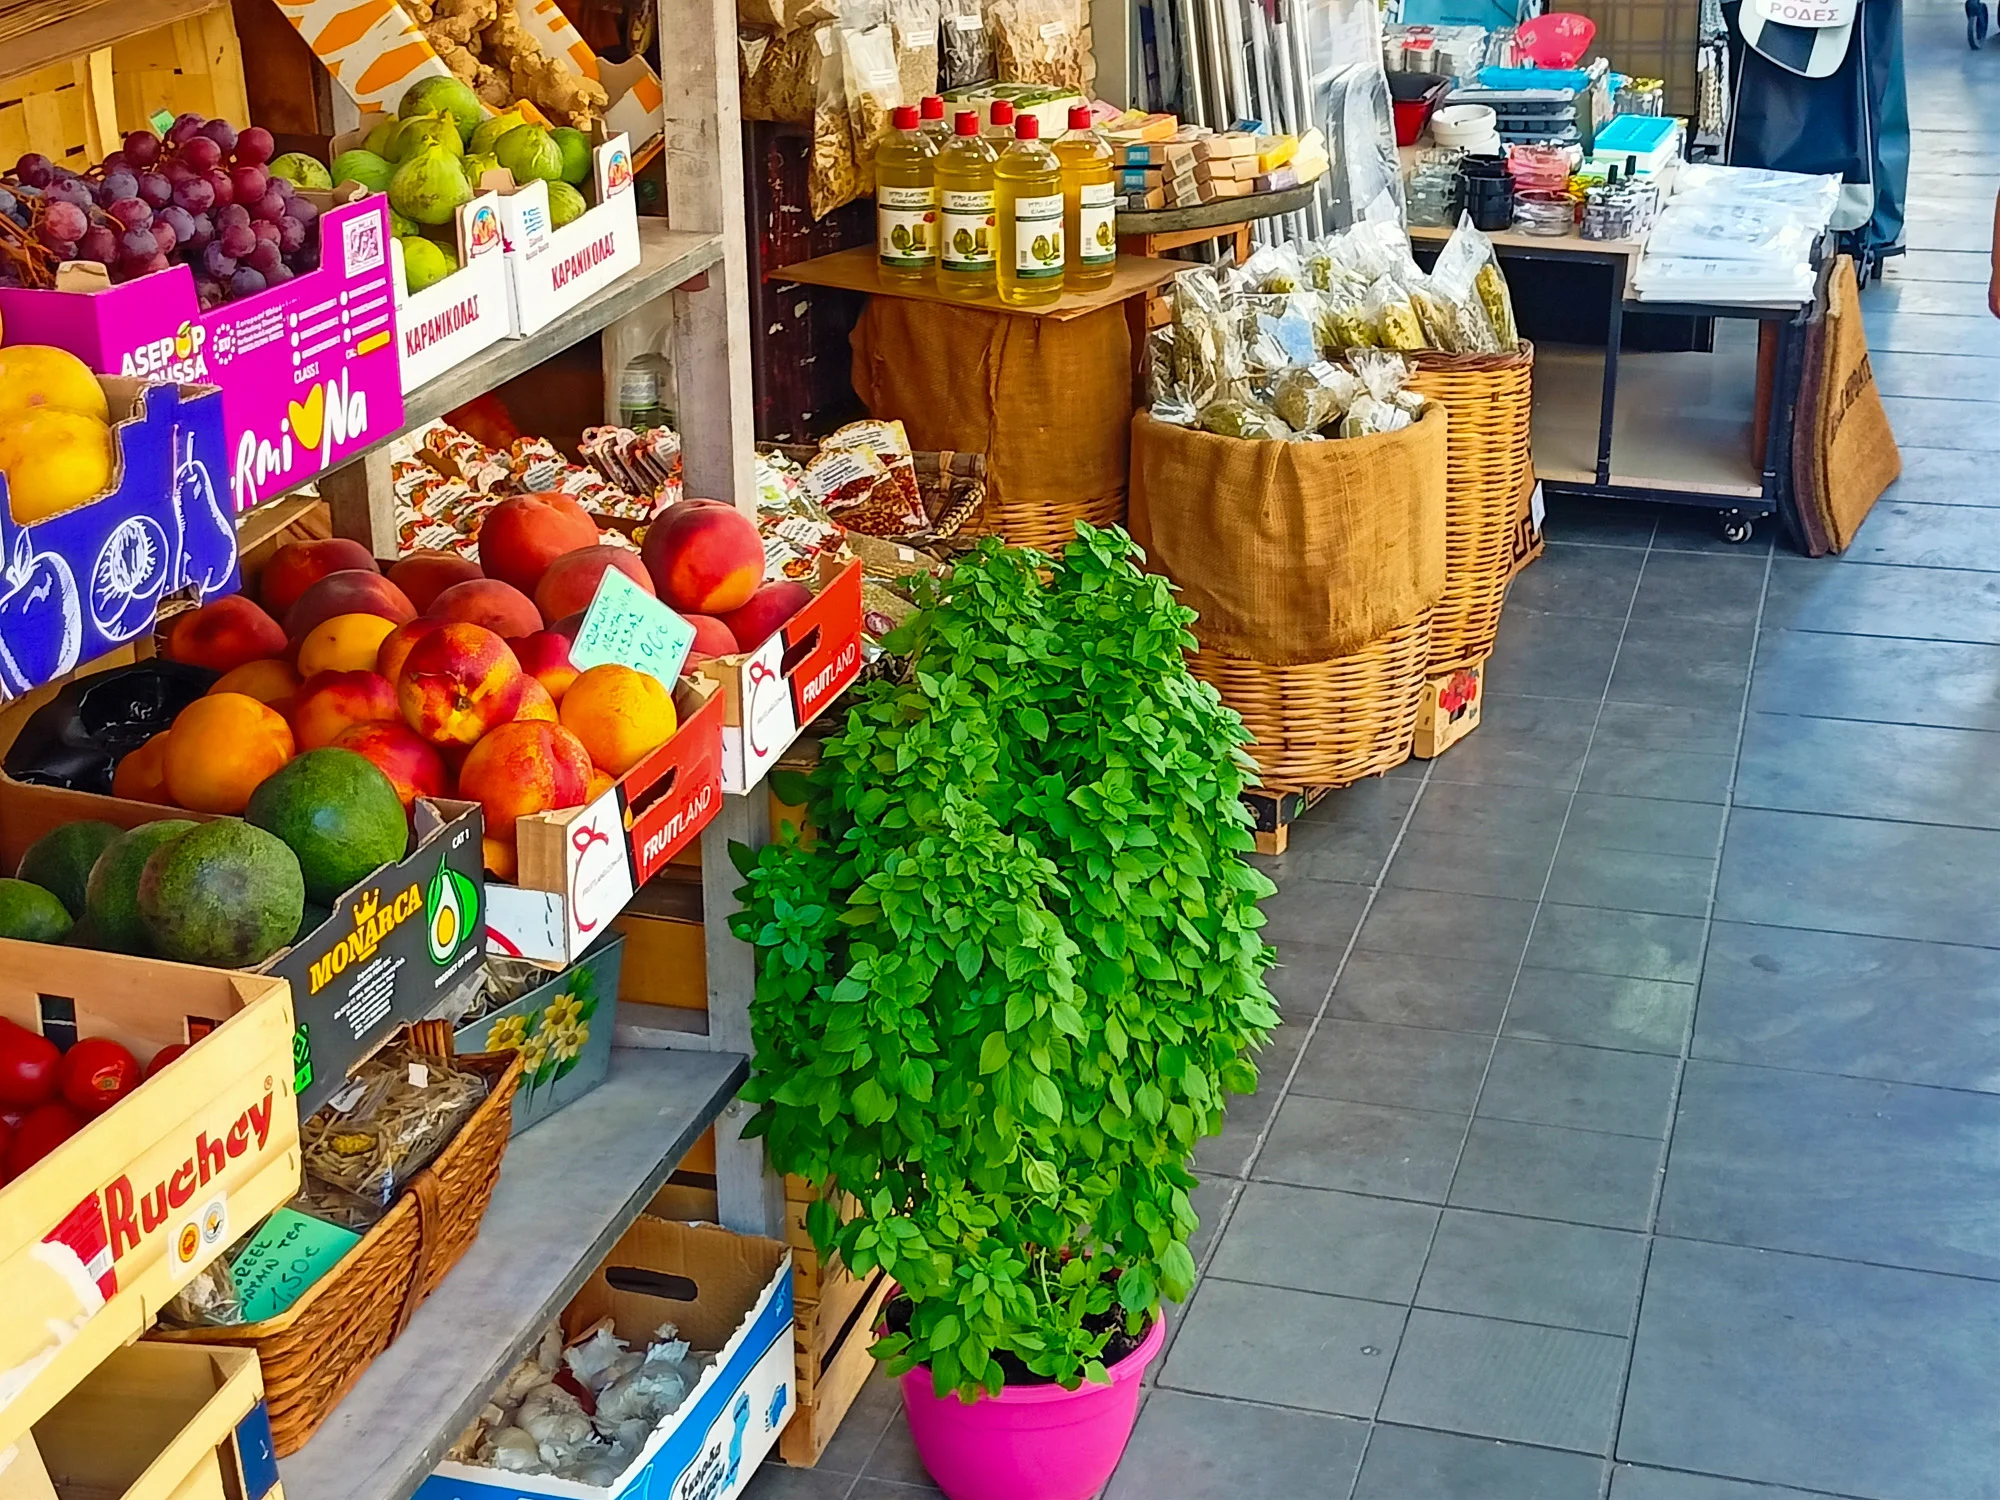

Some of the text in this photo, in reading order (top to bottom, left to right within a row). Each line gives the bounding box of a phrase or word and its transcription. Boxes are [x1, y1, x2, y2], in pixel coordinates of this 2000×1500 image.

[1770, 2, 1840, 21] ΡΟΔΕΣ
[551, 231, 616, 292] ΚΑΡΑΝΙΚΟΛΑΣ
[405, 294, 480, 358] ΚΑΡΑΝΙΚΟΛΑΣ
[294, 363, 315, 384] CLASS
[803, 643, 856, 706] FRUITLAND
[452, 833, 466, 850] CAT
[642, 785, 712, 868] FRUITLAND
[309, 883, 424, 995] MONARCA
[277, 1221, 308, 1249] TEA
